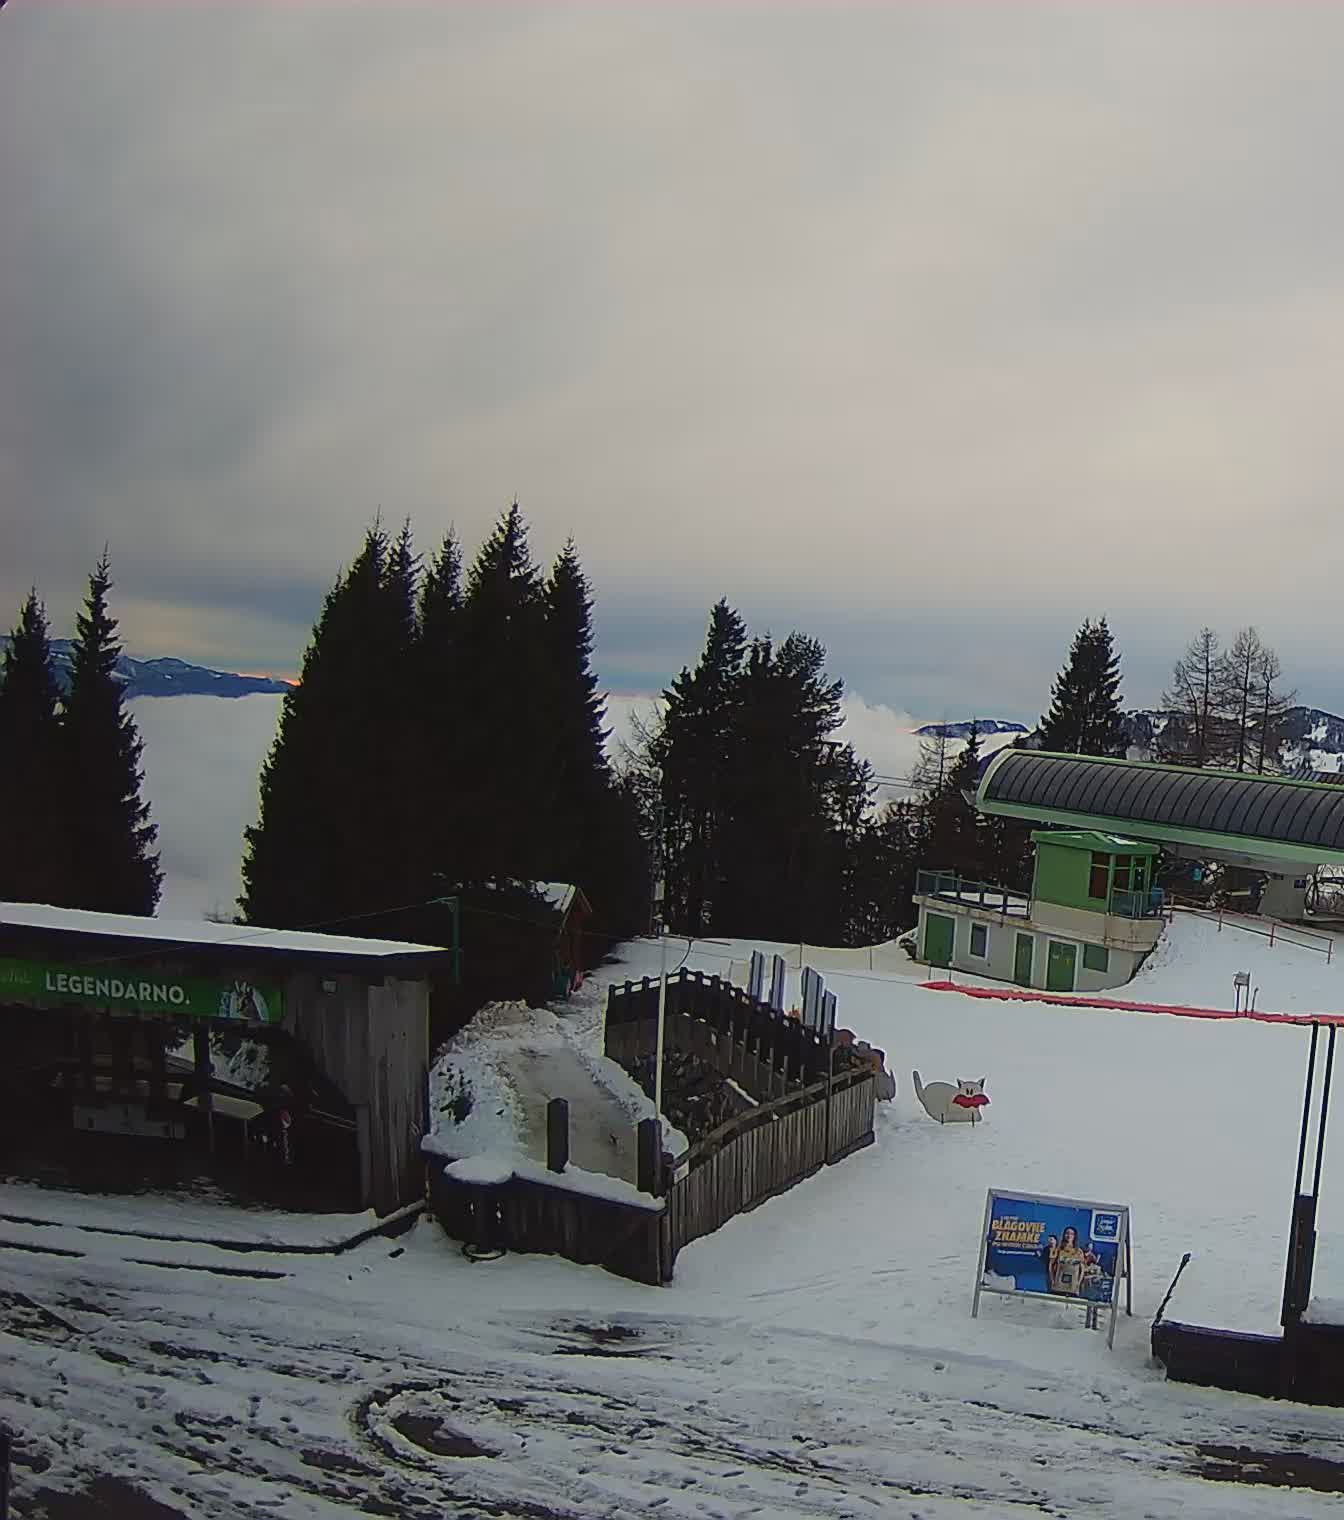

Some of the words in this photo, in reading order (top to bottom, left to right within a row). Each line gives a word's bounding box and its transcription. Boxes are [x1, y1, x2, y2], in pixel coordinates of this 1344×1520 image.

[45, 971, 191, 1005] LEGENDARNO.
[992, 1219, 1047, 1233] BLAGOVNE
[994, 1231, 1041, 1243] ZNAMKE
